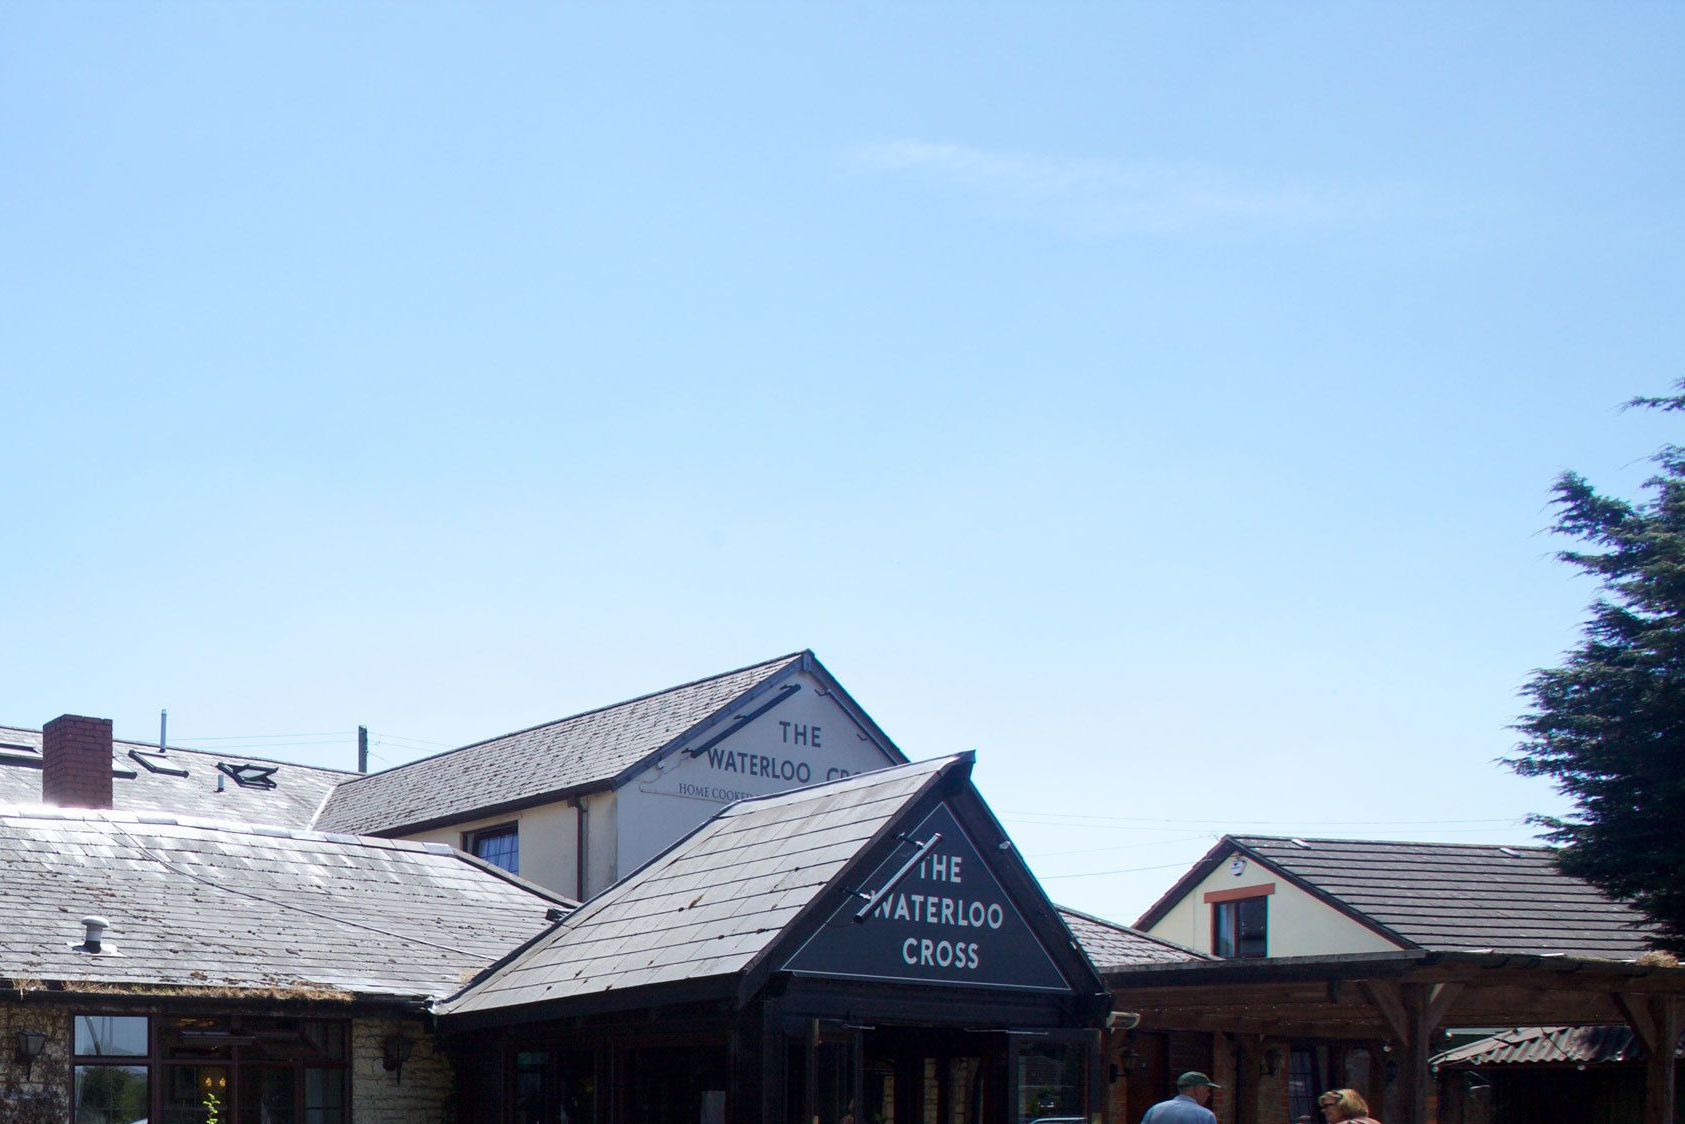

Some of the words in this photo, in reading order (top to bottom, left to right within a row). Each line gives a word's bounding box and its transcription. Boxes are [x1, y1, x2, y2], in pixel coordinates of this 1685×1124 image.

[779, 720, 822, 748] THE
[707, 748, 811, 784] WATERLOO
[679, 783, 709, 798] HOME
[919, 853, 962, 884] THE
[870, 889, 1004, 929] WATERLOO
[902, 937, 979, 969] CROSS
